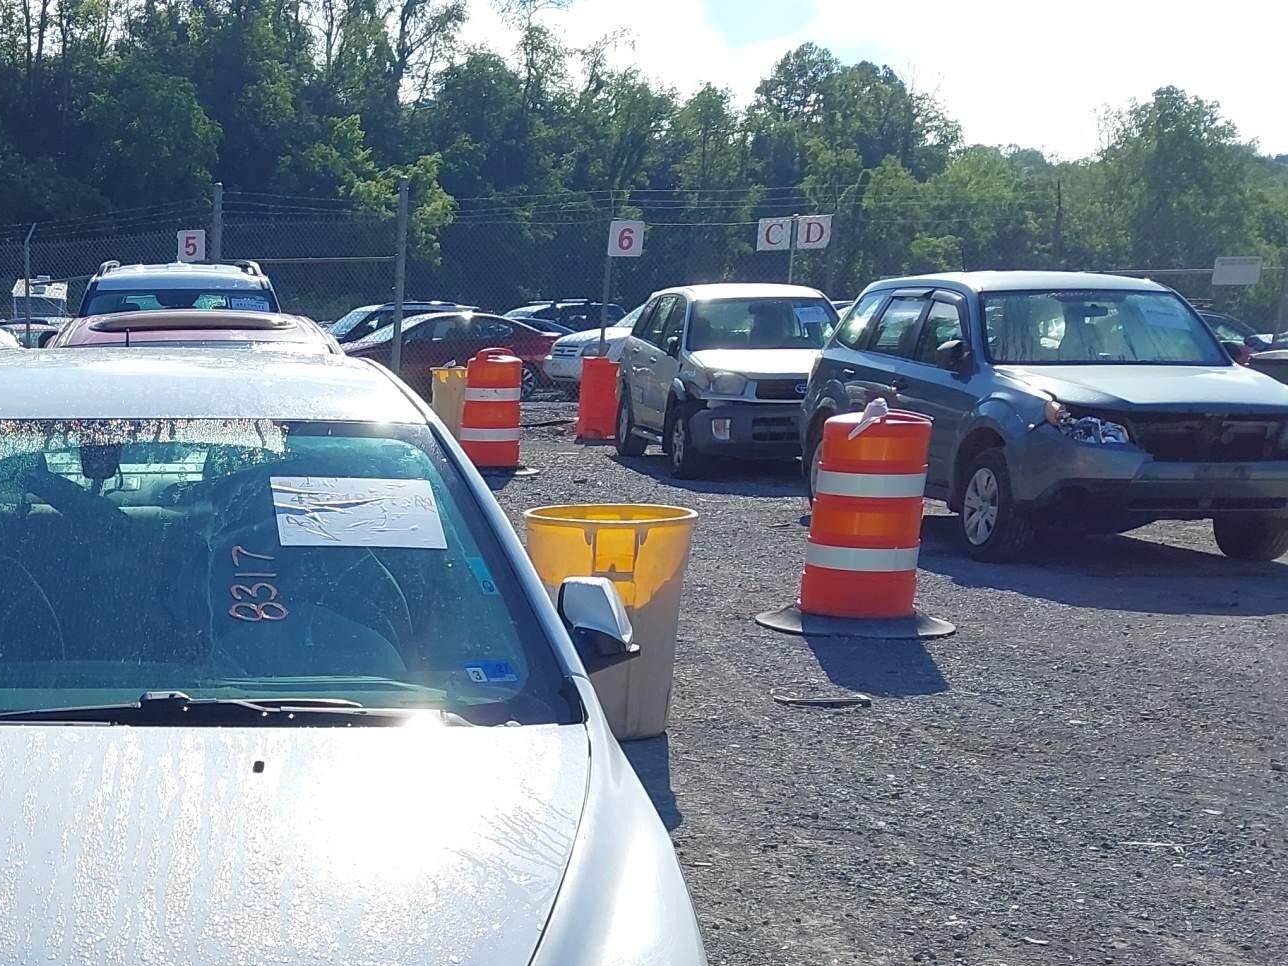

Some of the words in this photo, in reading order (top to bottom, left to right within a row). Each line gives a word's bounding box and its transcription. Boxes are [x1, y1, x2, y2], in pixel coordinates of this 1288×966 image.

[618, 228, 634, 251] 6
[765, 223, 784, 246] C
[804, 222, 825, 244] D
[185, 236, 198, 257] 5
[228, 545, 289, 622] 8317
[472, 670, 482, 681] 3
